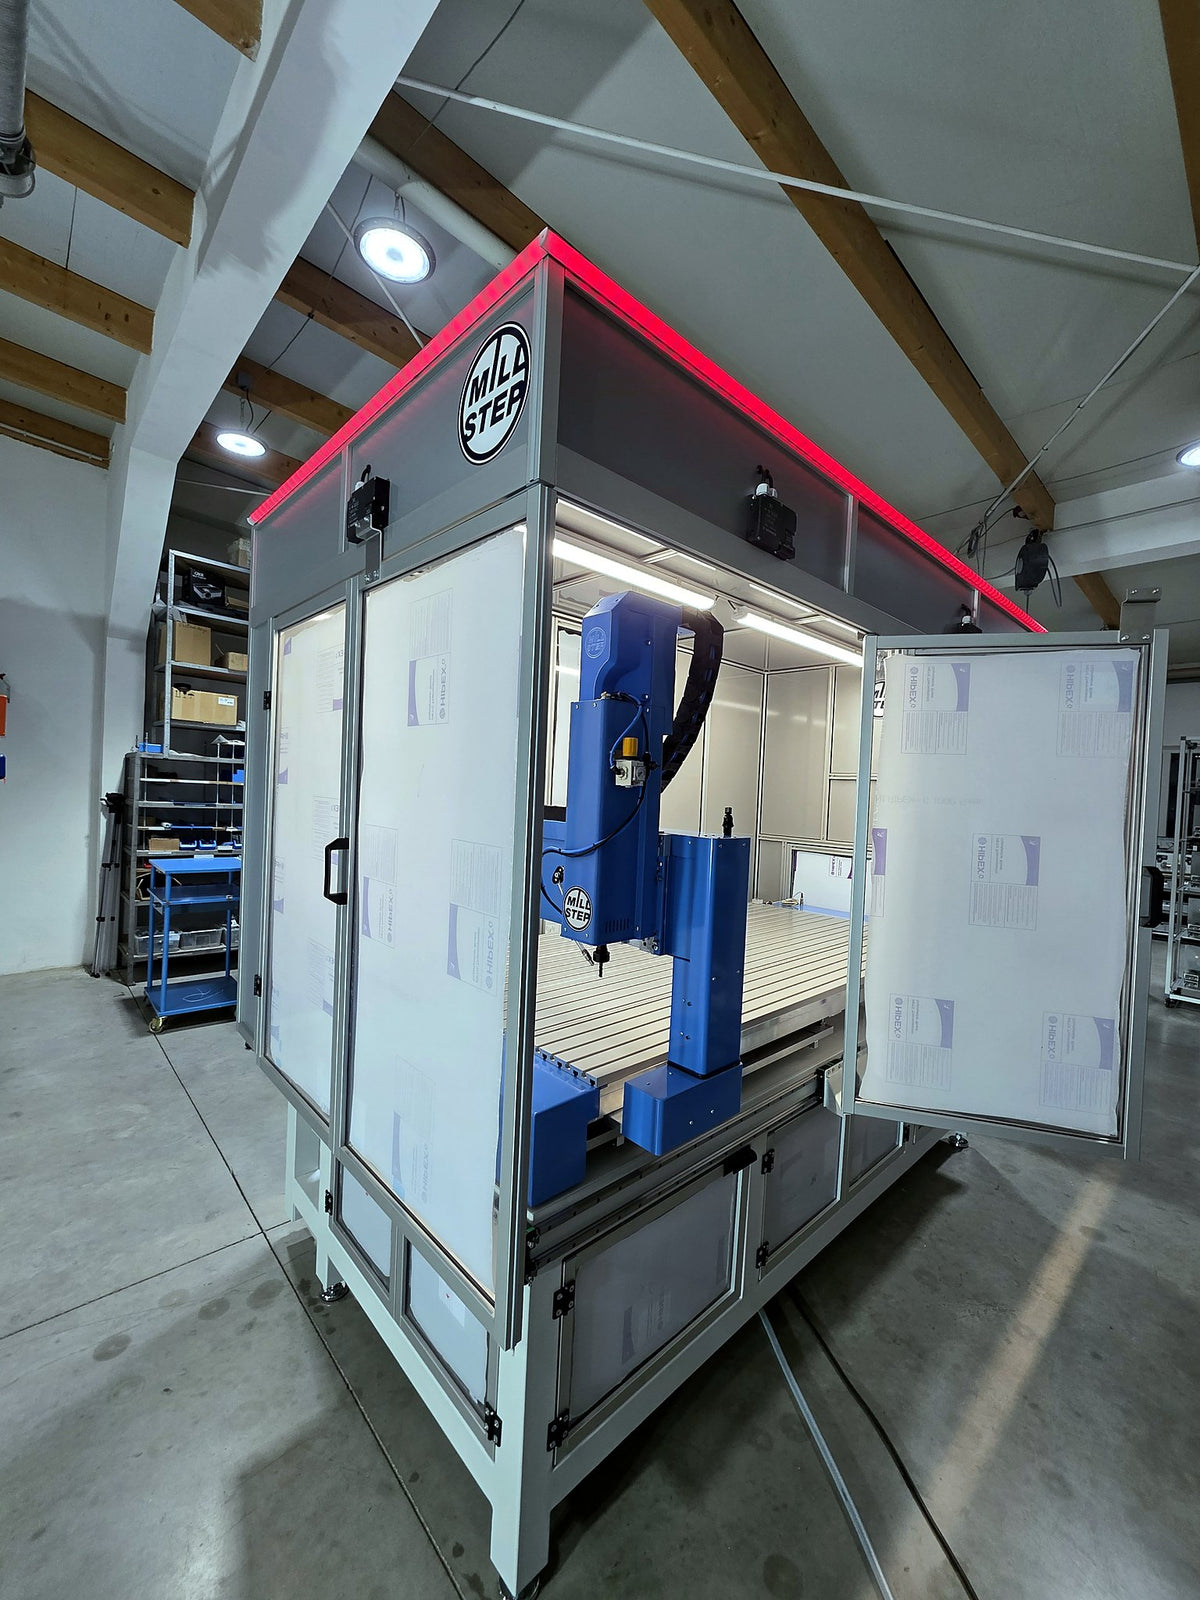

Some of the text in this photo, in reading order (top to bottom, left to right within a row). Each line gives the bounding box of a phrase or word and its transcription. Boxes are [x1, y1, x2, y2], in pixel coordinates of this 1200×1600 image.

[468, 337, 525, 408] MILL
[465, 380, 524, 441] STEP
[565, 908, 590, 921] STEP
[567, 890, 591, 910] MILL
